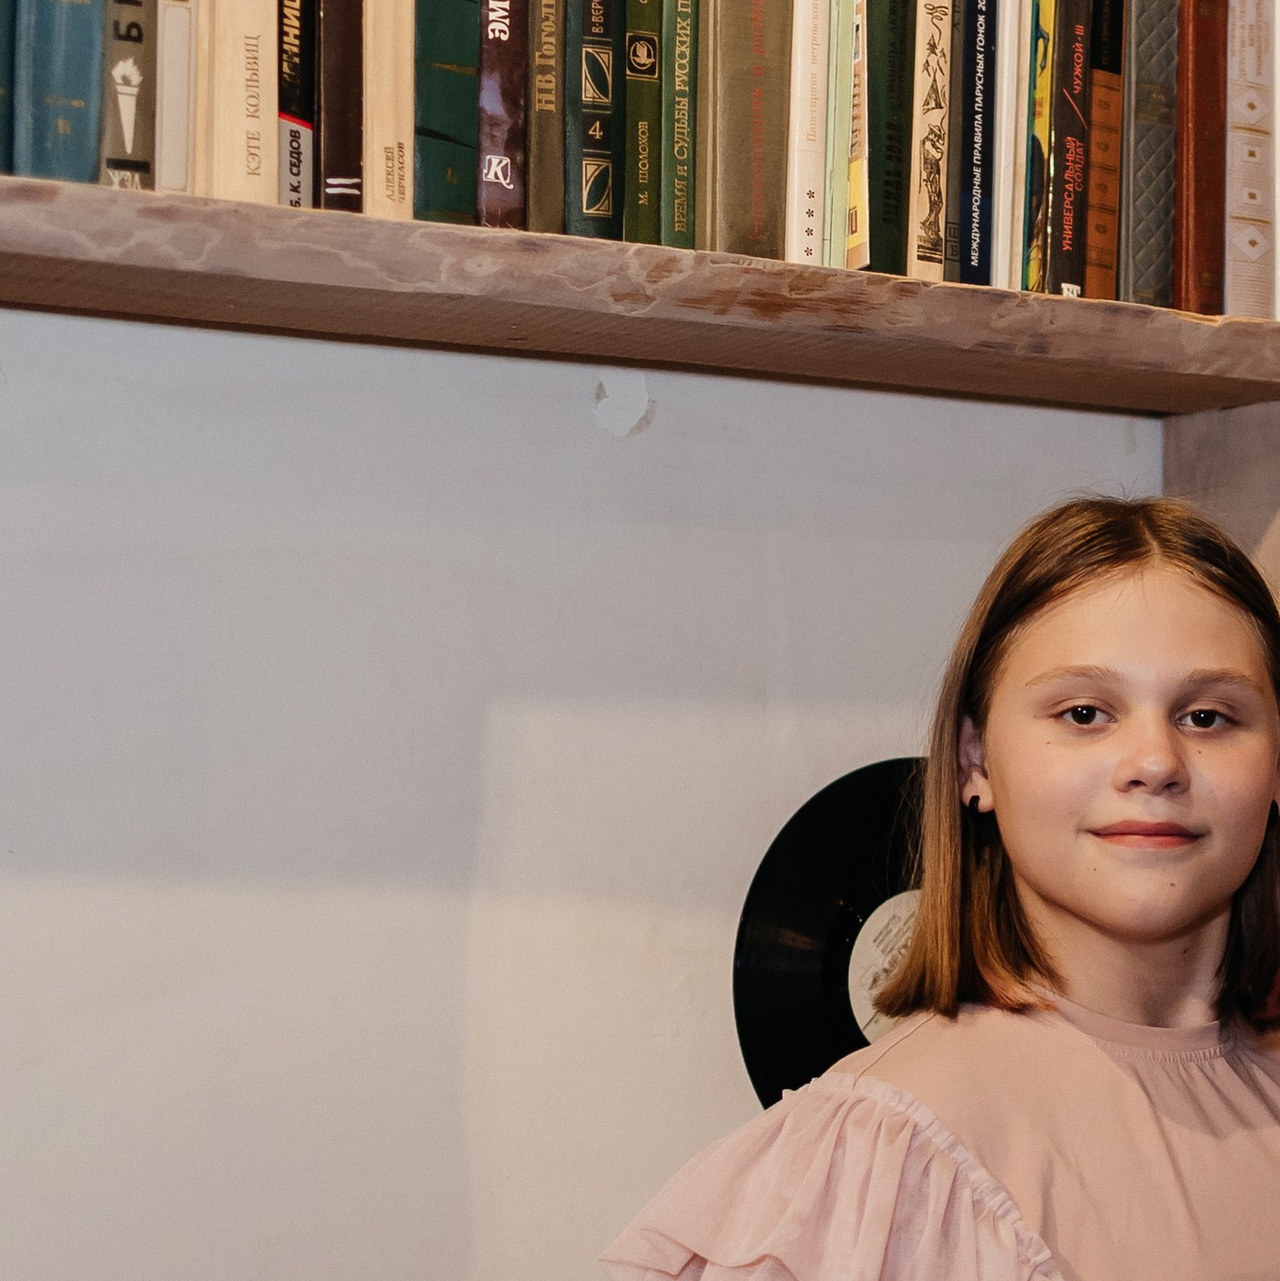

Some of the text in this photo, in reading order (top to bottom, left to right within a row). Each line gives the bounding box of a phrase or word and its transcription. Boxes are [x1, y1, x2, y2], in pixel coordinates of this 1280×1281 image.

[675, 17, 690, 92] РУССКИХ
[976, 14, 986, 51] ГОНОК
[244, 35, 261, 177] КЭТЕ КОЛЬВИЦ
[975, 53, 986, 112] ПАРУСНЫХ
[290, 129, 302, 177] СЕДОВ
[588, 120, 604, 139] 4
[638, 121, 649, 183] ШОЛОХОВ
[674, 96, 690, 160] СУДЬБЫ
[973, 113, 984, 165] ПРАВИЛА
[385, 147, 394, 202] АЛЕКСЕЙ
[1061, 136, 1076, 252] УНИВЕРСАЛЬНЫЙ
[1072, 141, 1084, 191] СОЛДАТ
[675, 180, 687, 233] ВРЕМЯ
[970, 166, 985, 267] МЕЖДУНАРОДНЫЕ
